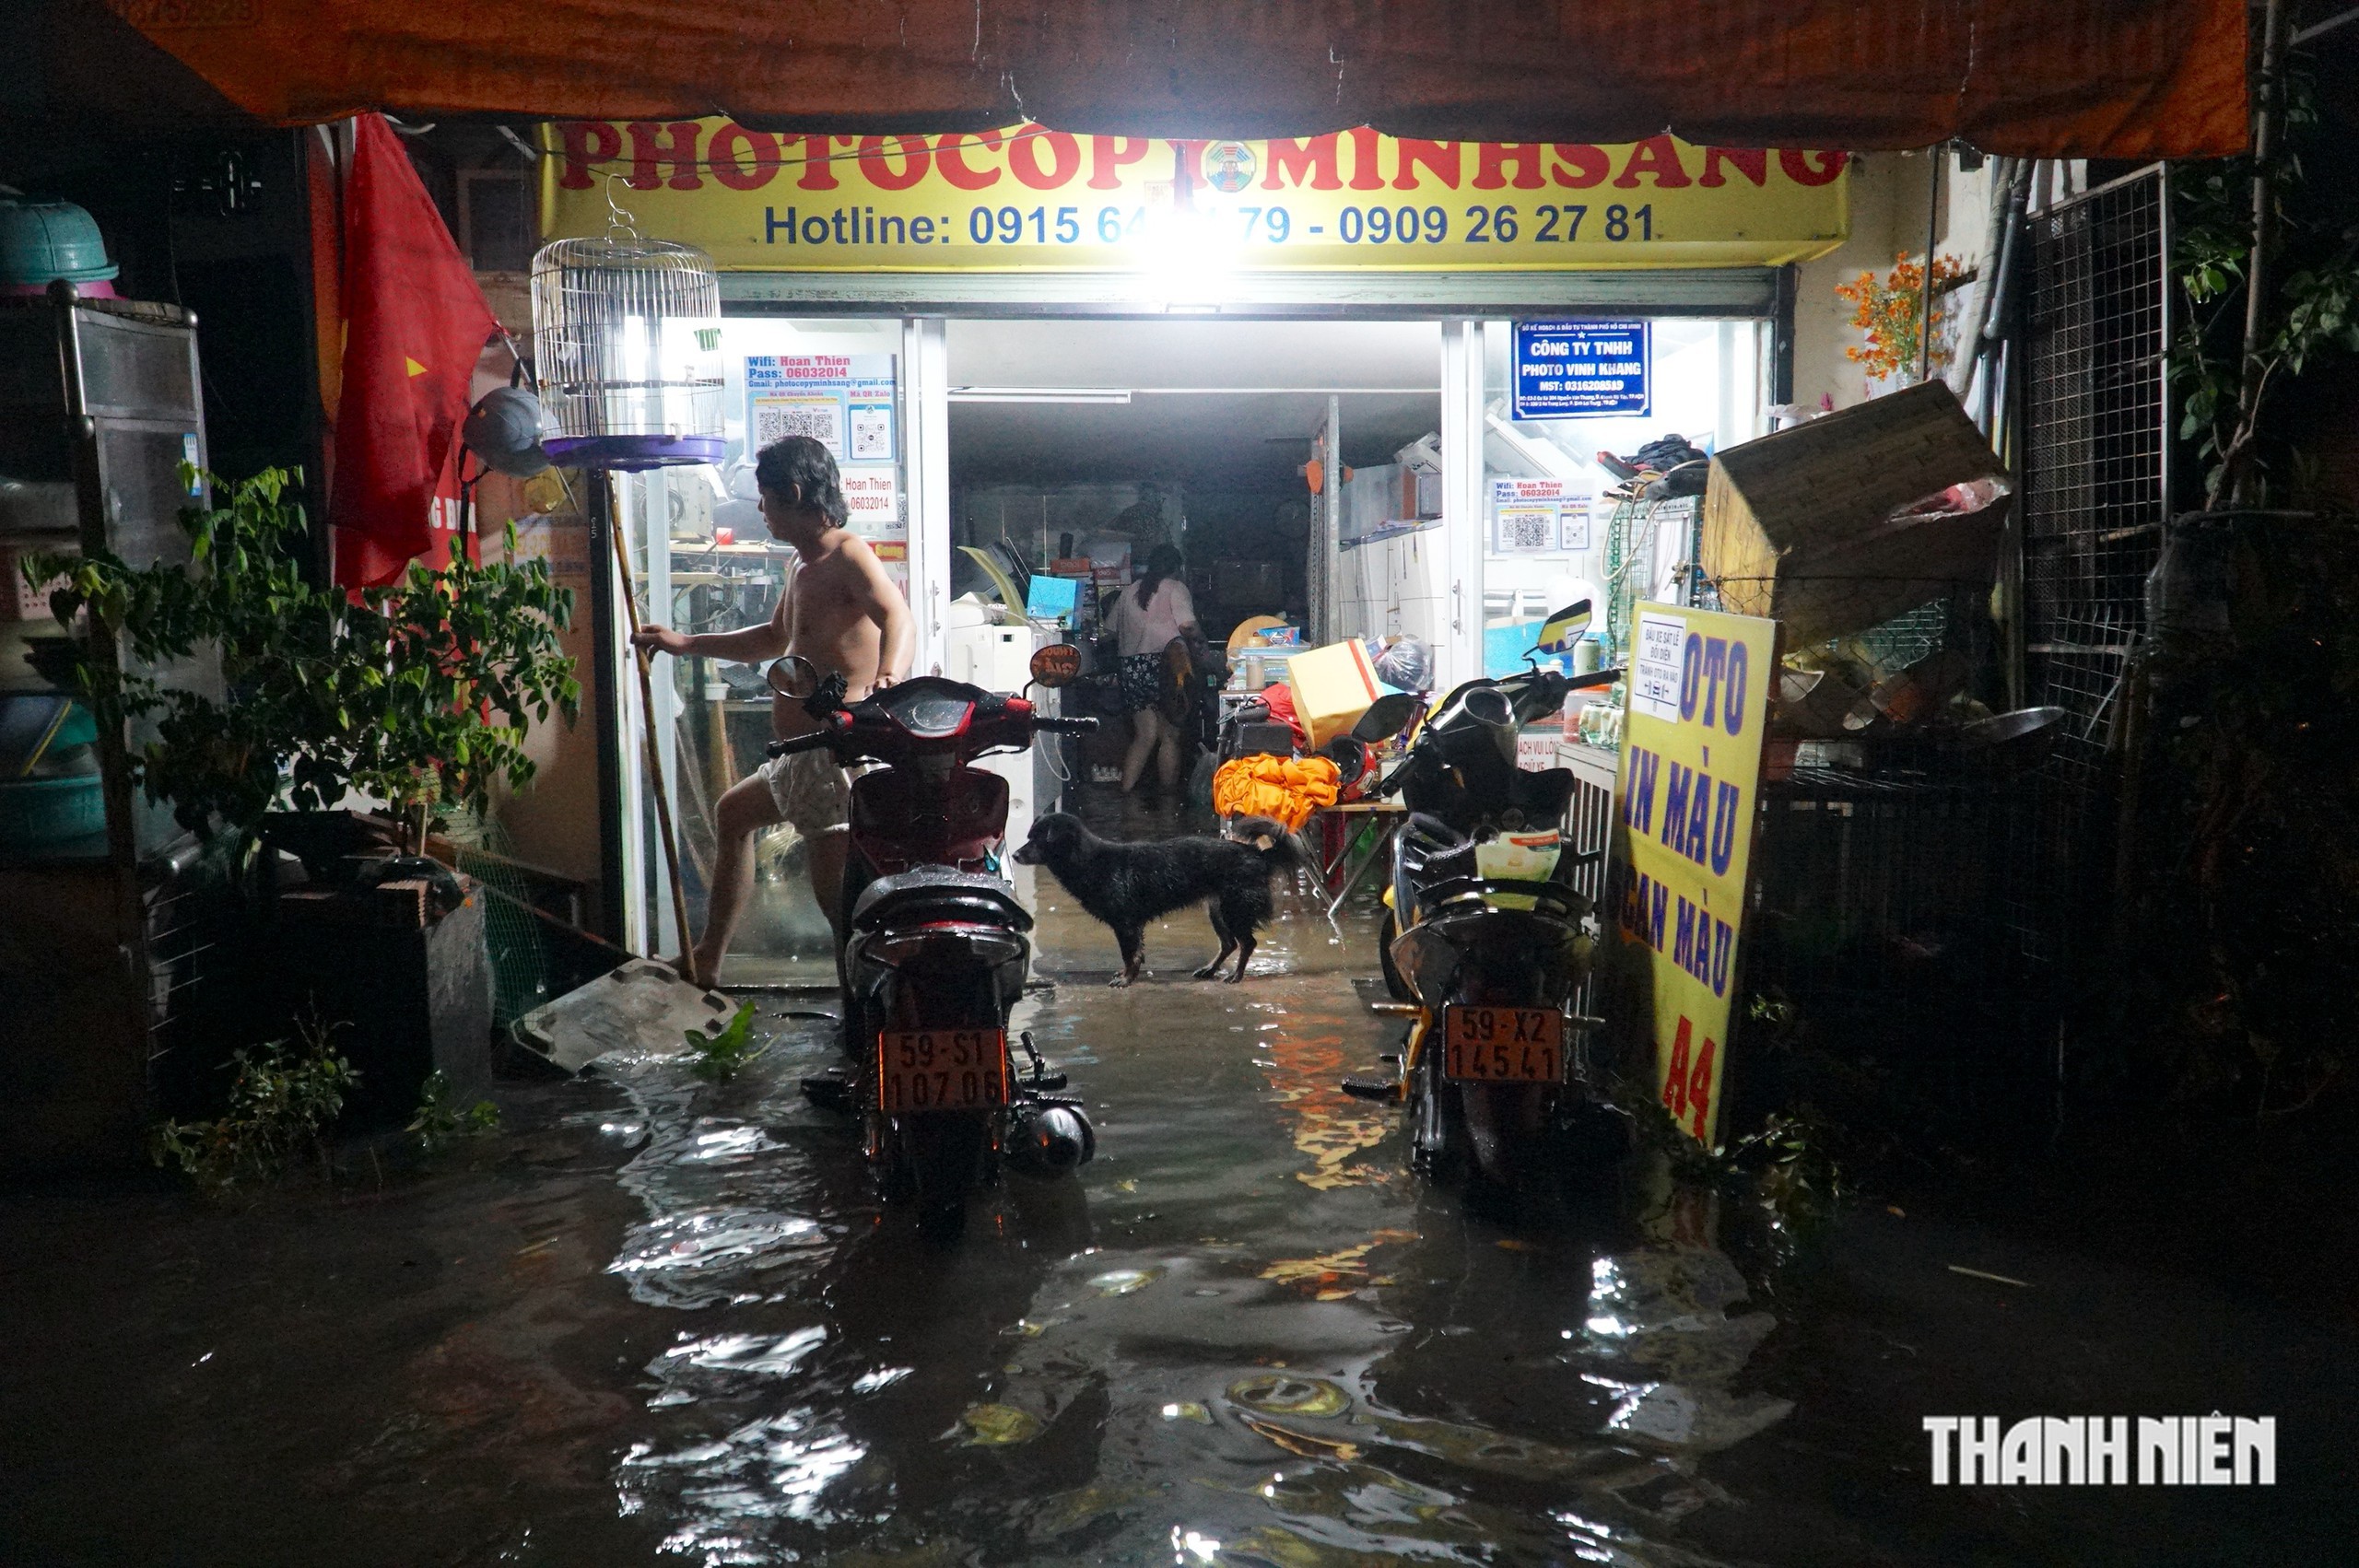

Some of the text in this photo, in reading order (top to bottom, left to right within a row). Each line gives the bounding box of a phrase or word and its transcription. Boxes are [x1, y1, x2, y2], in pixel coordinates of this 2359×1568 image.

[556, 120, 1209, 192] PHOTOCOPY
[765, 205, 951, 245] Hotline:
[968, 205, 1080, 244] 0915
[1238, 205, 1290, 244] 79
[1339, 206, 1449, 244] 0909
[1465, 205, 1520, 243] 26
[1535, 205, 1588, 242] 27
[1605, 204, 1655, 242] 81
[1531, 339, 1633, 357] CÔNG TY TNHH
[748, 356, 851, 367] Wifi: Hoan Thien
[1522, 362, 1642, 377] PHOTO VINH KHANG
[748, 367, 847, 379] Pass: 06032014
[748, 380, 773, 388] Gmail:
[1540, 381, 1563, 392] MST:
[846, 478, 892, 491] Hoan Thien
[851, 497, 888, 510] 06032014
[1656, 630, 1663, 643] XE
[1663, 671, 1669, 682] RA
[1680, 632, 1748, 737] OTO
[1624, 744, 1740, 877] IN MÀU
[1673, 887, 1733, 999] MÀU
[1461, 1010, 1546, 1043] 59-X2
[899, 1032, 983, 1068] 59-S1
[1662, 1013, 1717, 1141] A4
